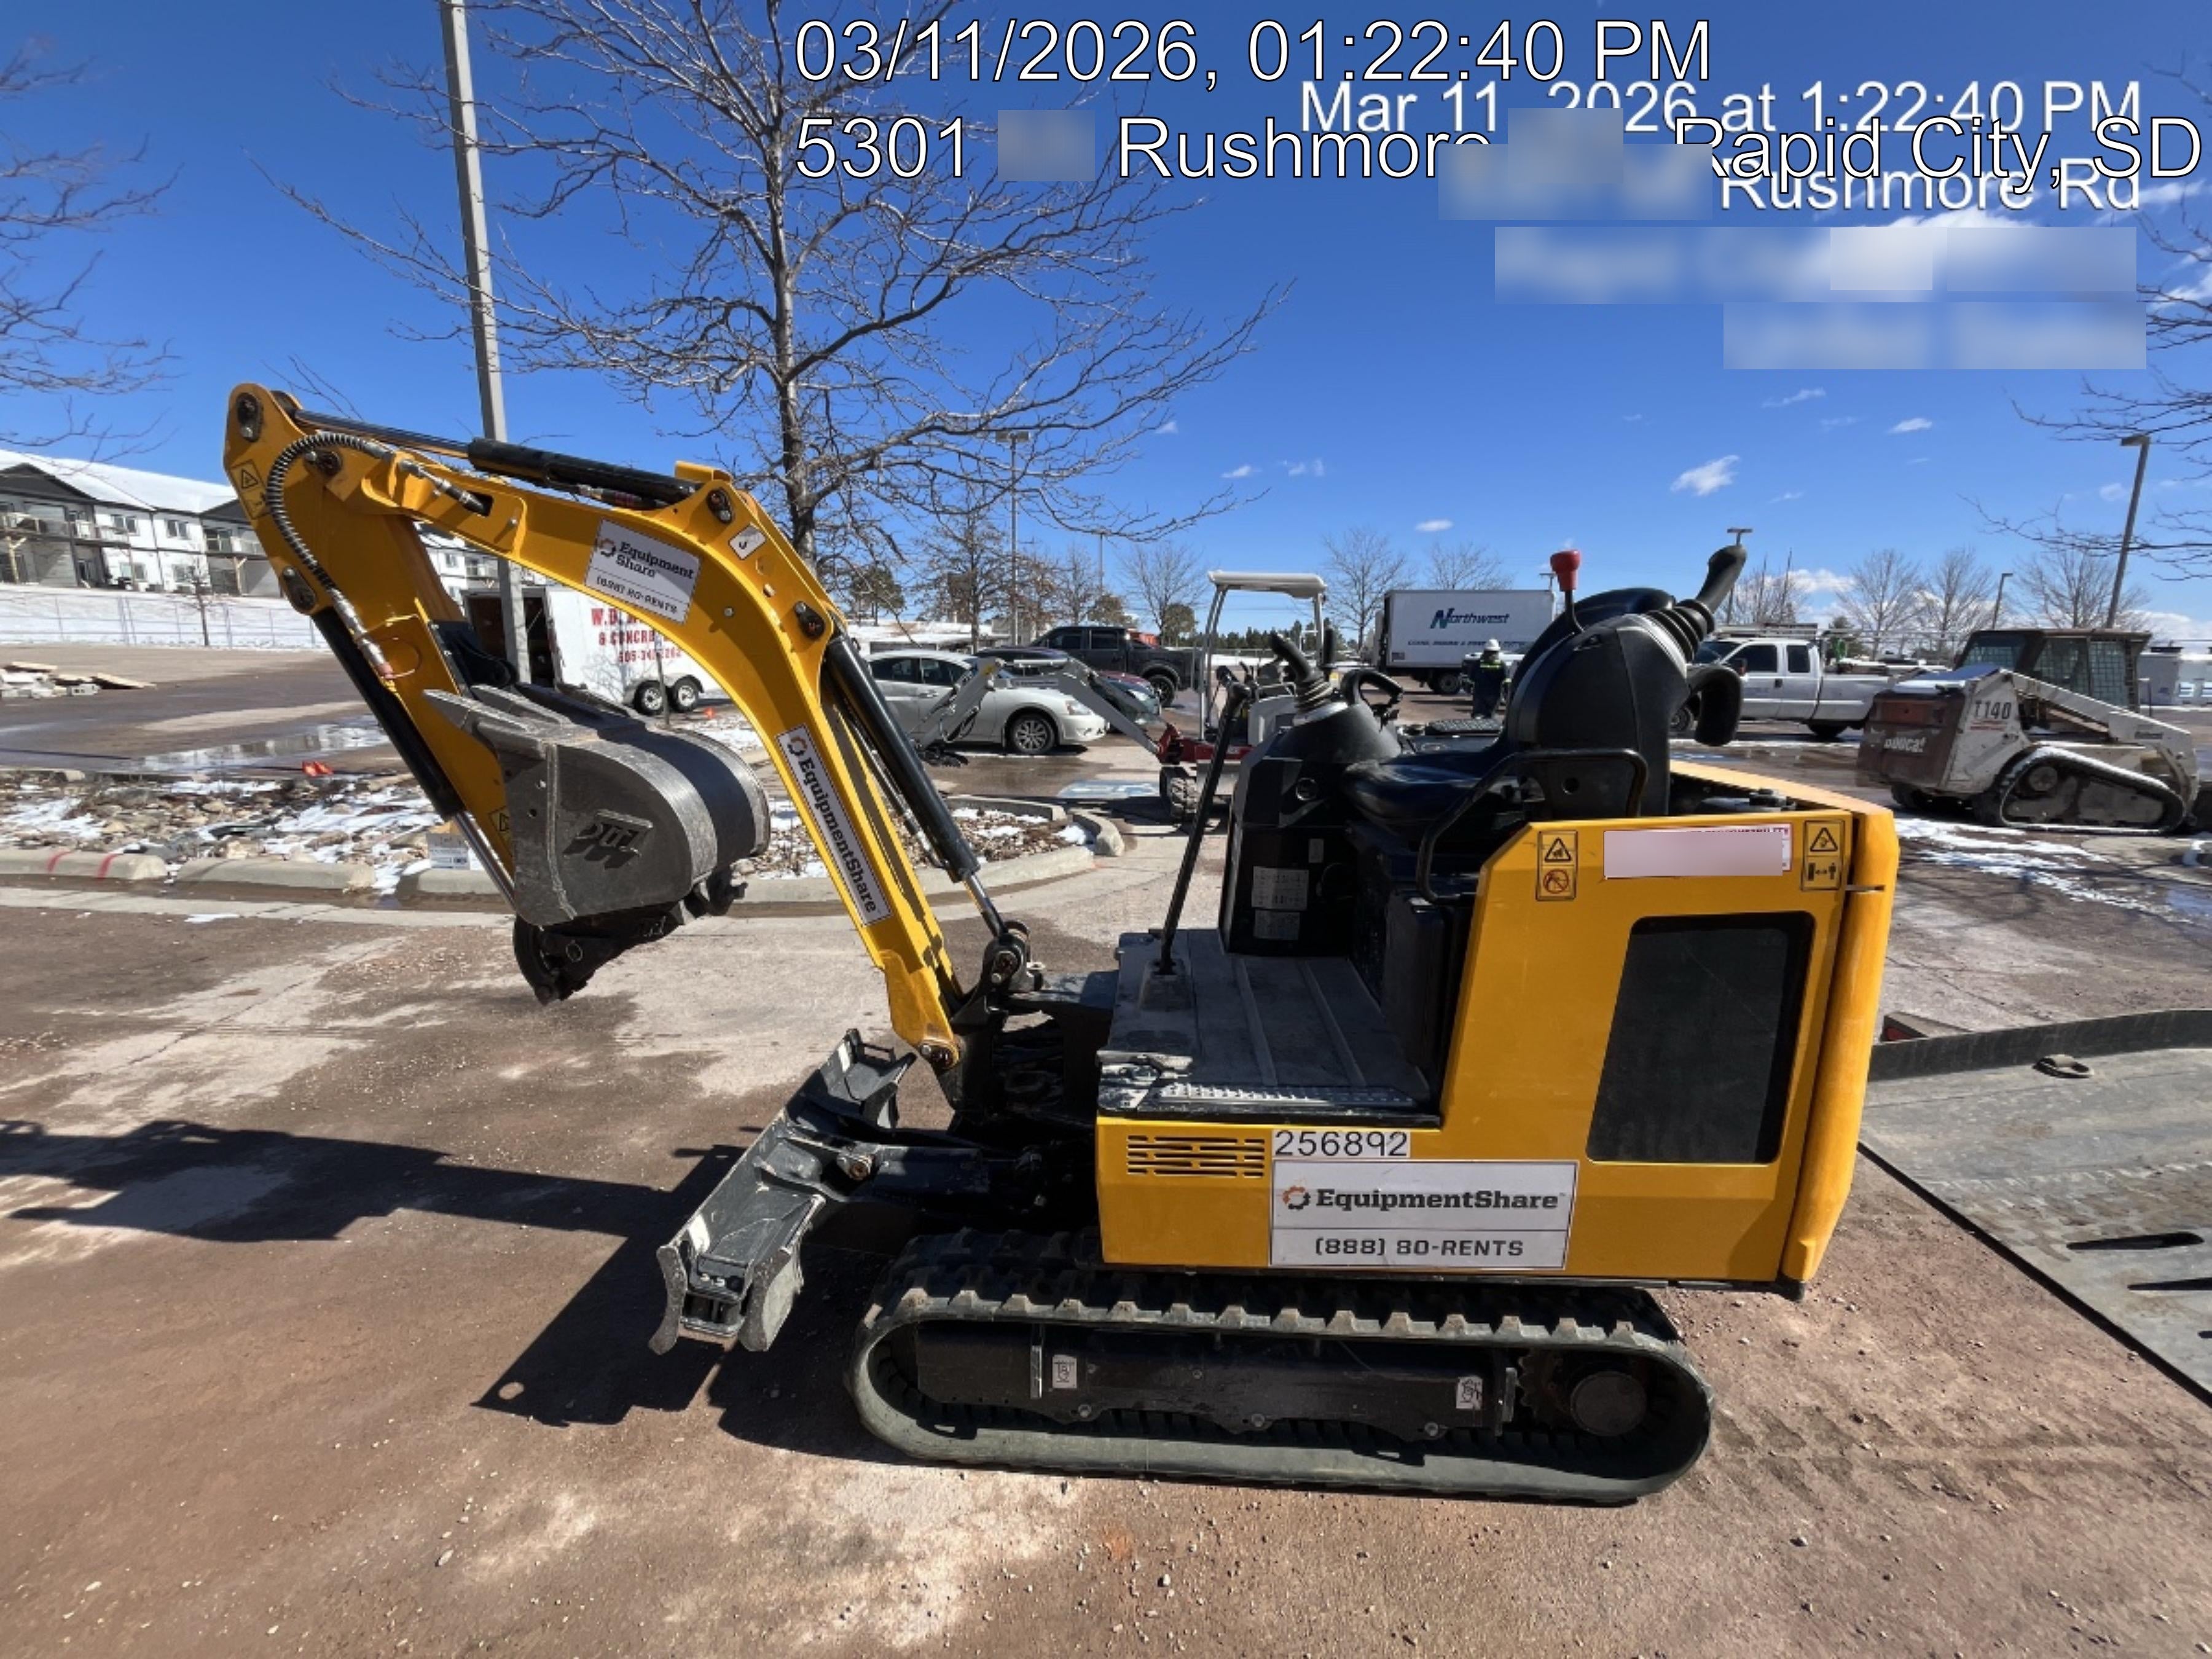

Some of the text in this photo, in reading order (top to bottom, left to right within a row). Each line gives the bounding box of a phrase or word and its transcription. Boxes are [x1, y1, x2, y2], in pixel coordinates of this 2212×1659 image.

[615, 554, 656, 578] Share
[619, 541, 693, 579] Equipment
[1430, 608, 1510, 629] Northwest
[798, 756, 877, 914] EquipmentShare
[1275, 1130, 1408, 1157] 256892
[1316, 1188, 1558, 1211] EquipmentShare
[1315, 1238, 1524, 1257] (888) 80-RENTS
